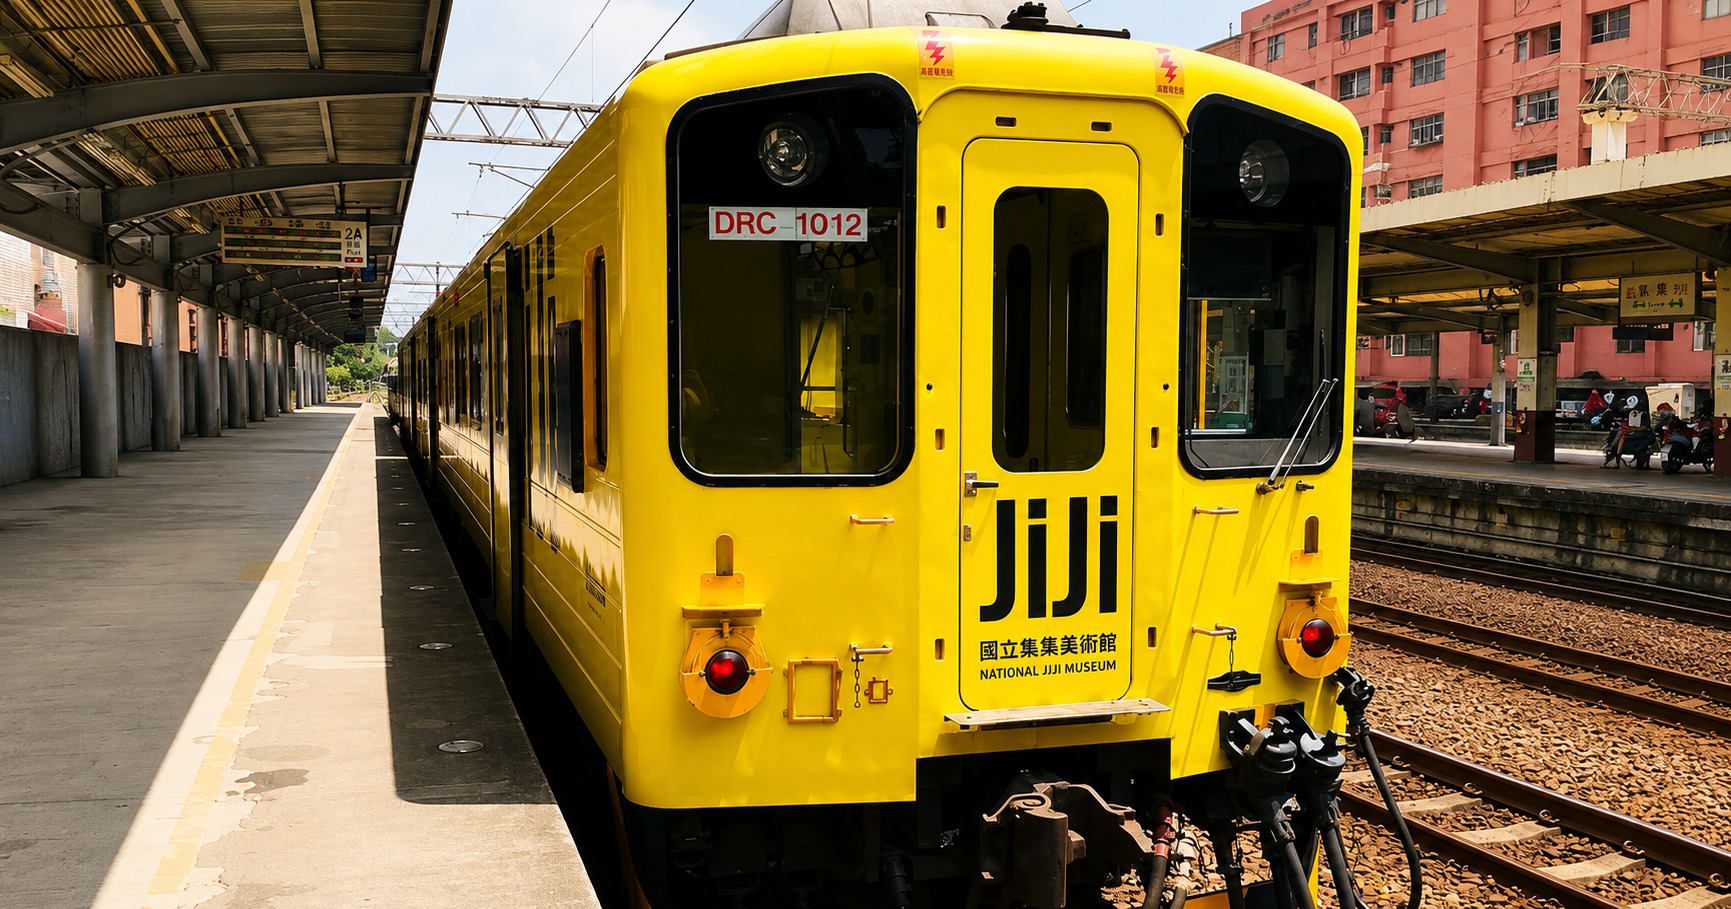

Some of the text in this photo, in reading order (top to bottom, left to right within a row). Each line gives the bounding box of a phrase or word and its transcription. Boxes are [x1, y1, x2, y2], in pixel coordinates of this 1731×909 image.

[345, 227, 362, 240] 2A
[715, 211, 861, 236] DRC 1012
[979, 495, 1118, 622] JiJi
[980, 632, 1117, 662] 國立集集美術館
[980, 665, 1039, 680] NATIONAL
[1064, 659, 1116, 674] MUSEUM
